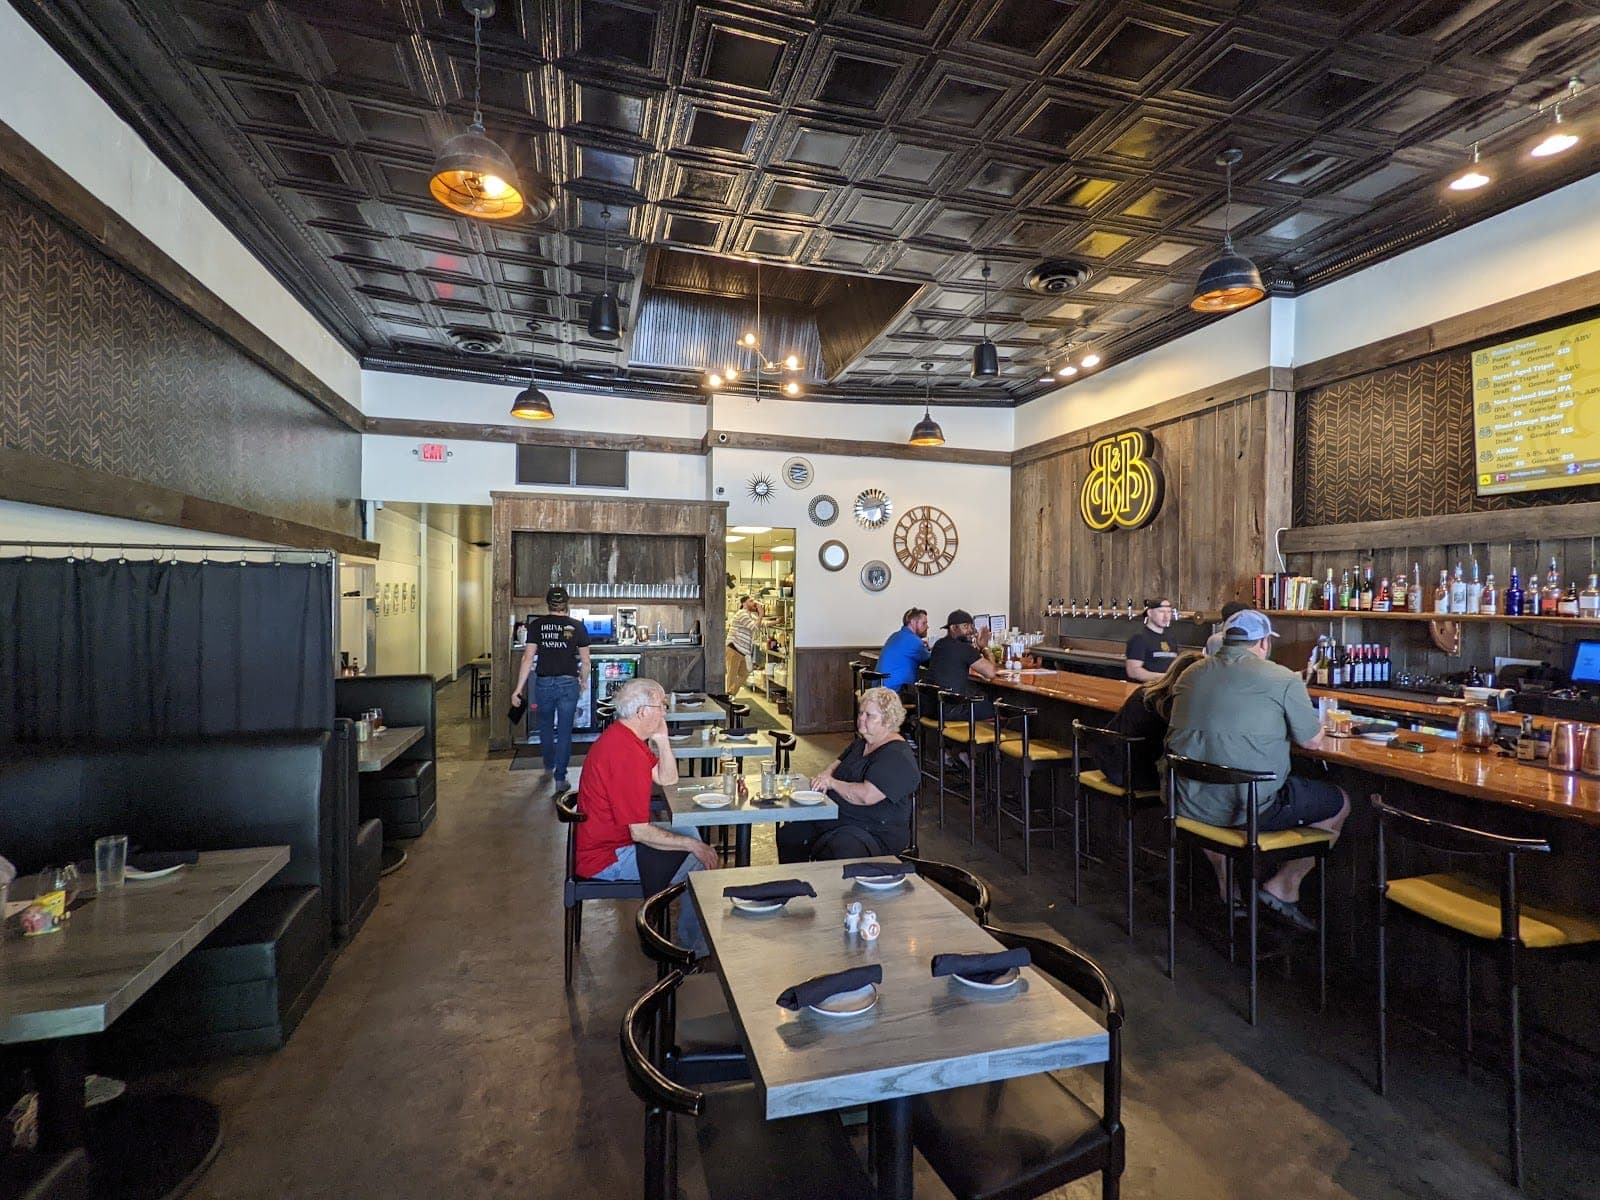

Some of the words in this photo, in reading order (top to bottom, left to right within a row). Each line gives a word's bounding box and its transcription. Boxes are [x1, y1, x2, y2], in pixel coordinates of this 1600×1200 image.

[1574, 333, 1592, 343] ABV
[1492, 363, 1509, 371] Draft
[1564, 363, 1581, 372] ABV
[1492, 372, 1513, 381] Barrel
[1493, 388, 1510, 396] Draft
[1510, 392, 1537, 402] Zealand
[1557, 384, 1572, 393] IPA
[1494, 413, 1511, 421] Draft
[1496, 437, 1511, 445] Draft
[1497, 462, 1512, 470] Draft
[541, 632, 559, 640] YOUR
